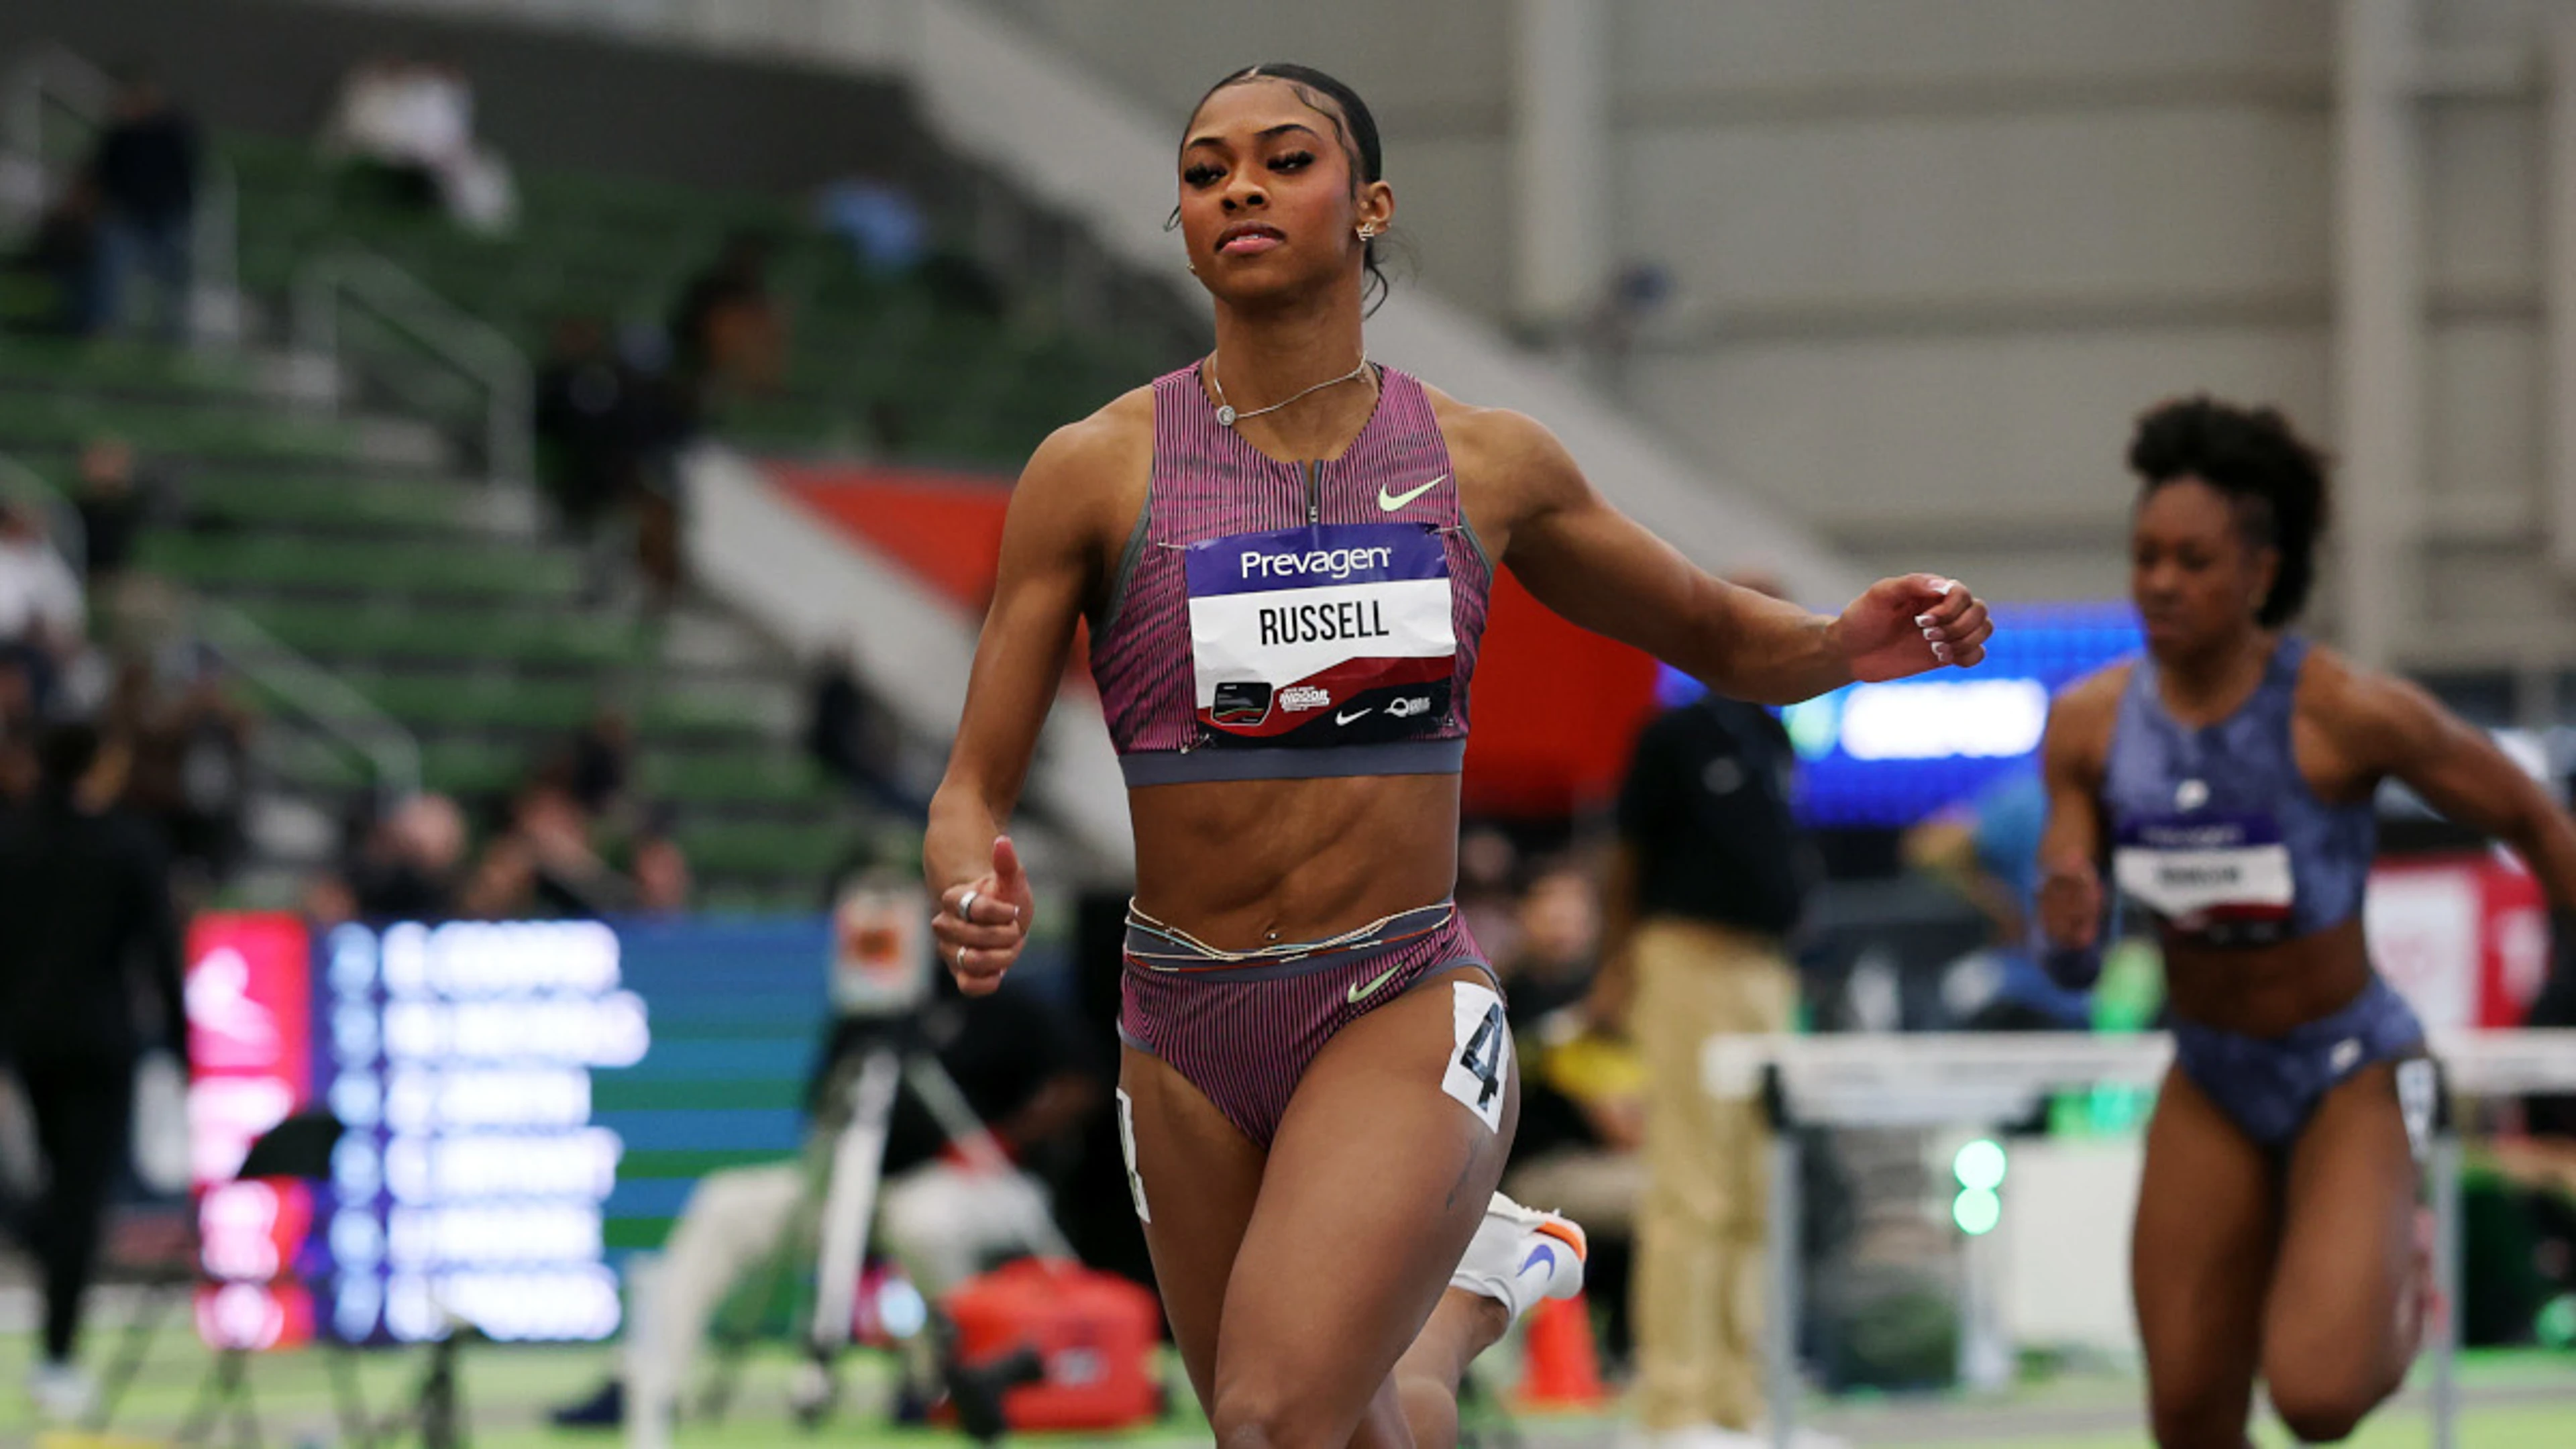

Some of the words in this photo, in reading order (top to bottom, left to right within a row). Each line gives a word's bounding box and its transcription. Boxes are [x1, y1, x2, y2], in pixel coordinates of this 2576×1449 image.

[1241, 547, 1389, 579] Prevagen
[1259, 599, 1390, 645] RUSSELL
[1460, 1002, 1503, 1113] 4
